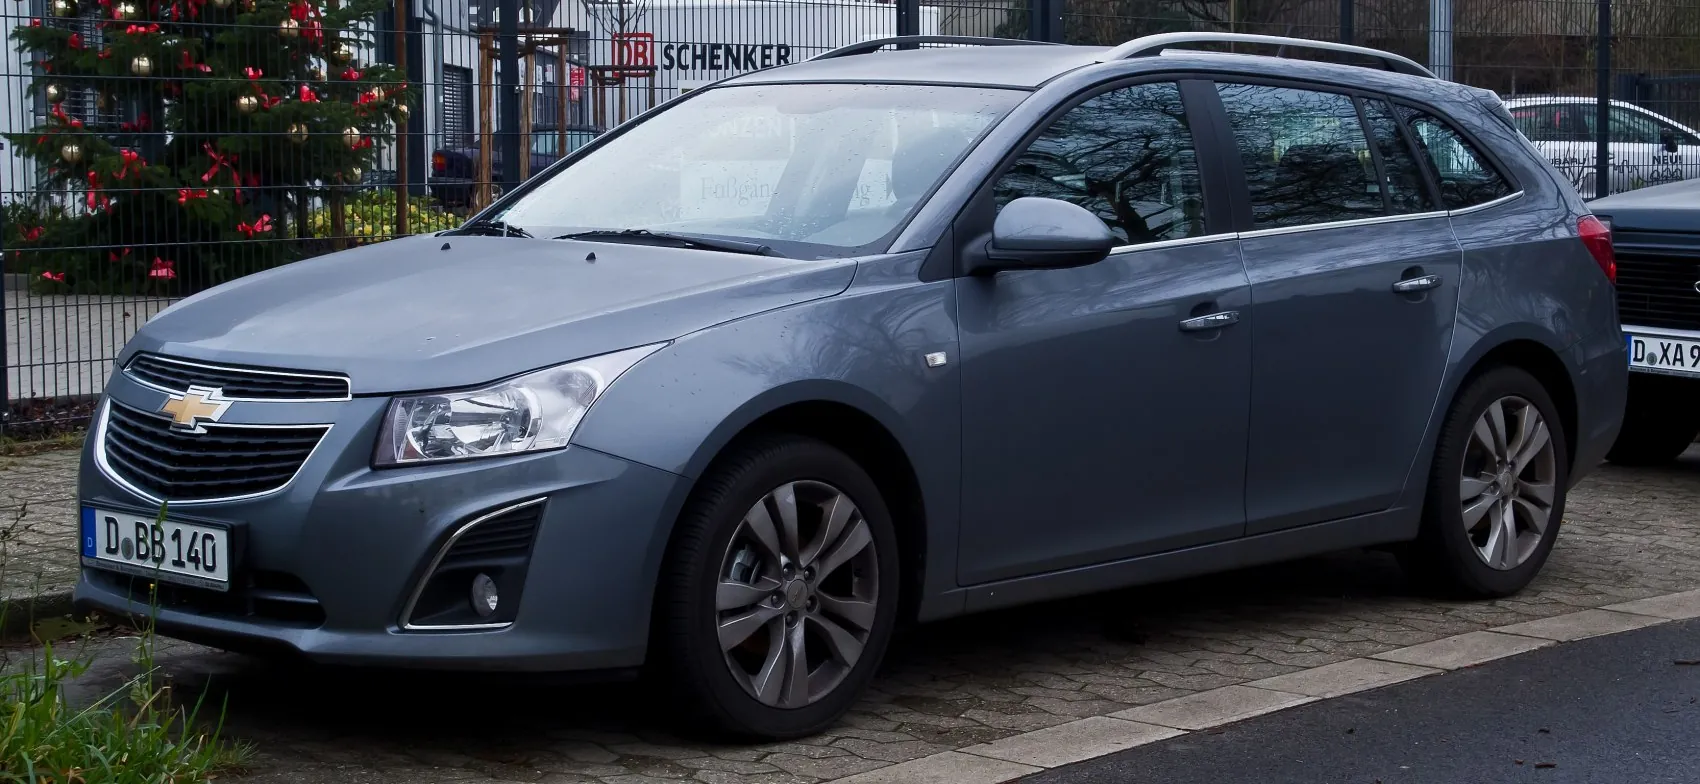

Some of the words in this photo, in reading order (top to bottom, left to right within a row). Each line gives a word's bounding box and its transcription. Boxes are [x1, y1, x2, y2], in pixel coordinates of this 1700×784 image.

[615, 38, 651, 69] DB
[662, 43, 791, 71] SCHENKER
[1652, 154, 1682, 165] NEU!
[1633, 339, 1645, 363] D
[1659, 341, 1685, 367] XA
[87, 536, 93, 548] D
[104, 516, 119, 555] D
[135, 521, 166, 563] BB
[171, 527, 217, 572] 140
